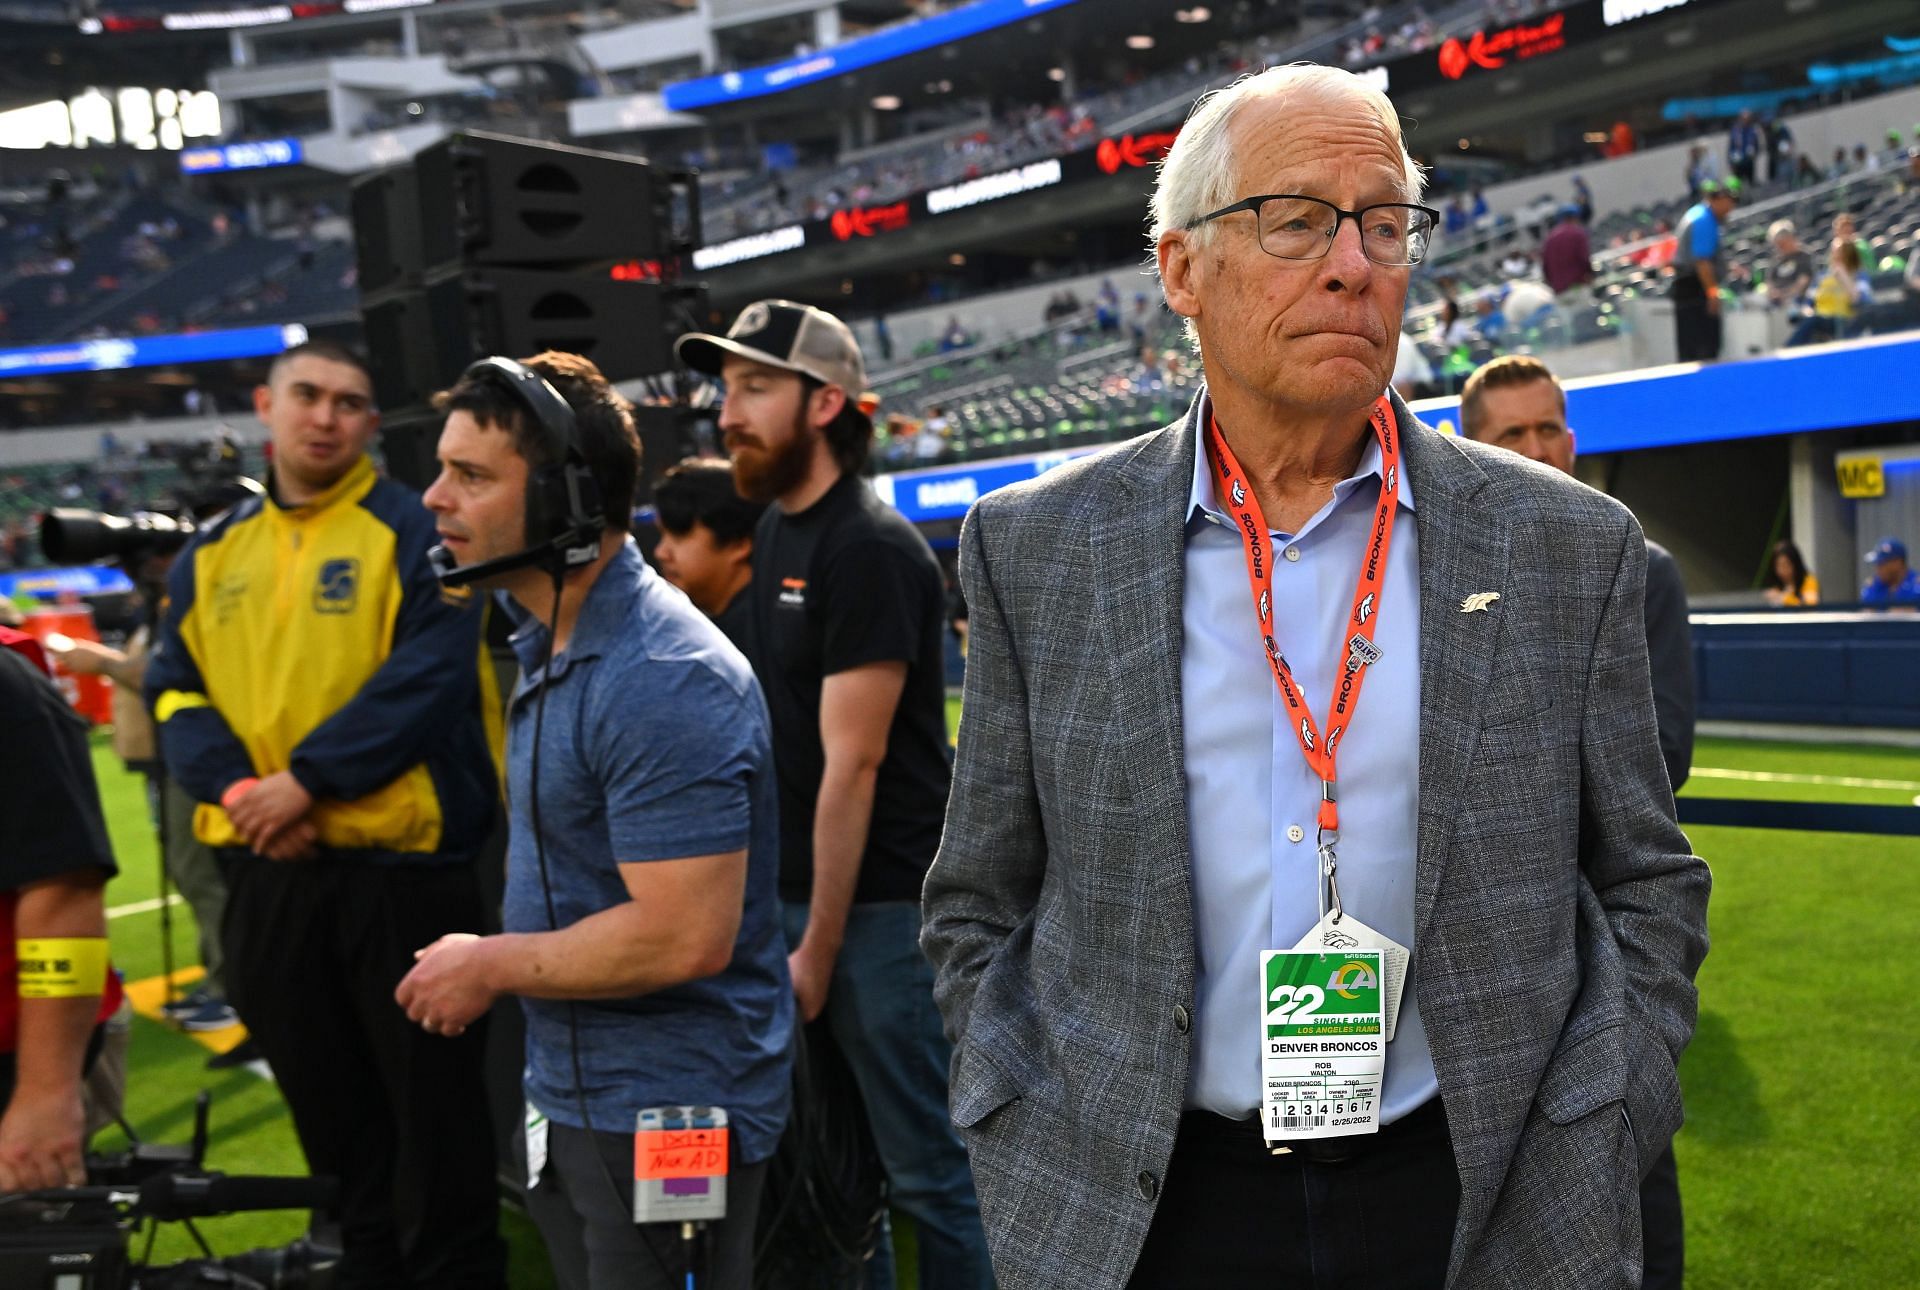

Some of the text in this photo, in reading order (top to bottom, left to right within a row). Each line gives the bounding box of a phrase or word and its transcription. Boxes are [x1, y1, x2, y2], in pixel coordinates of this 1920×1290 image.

[1240, 512, 1264, 579] BRONCOS
[1366, 504, 1388, 581] BRONCOS
[1350, 637, 1378, 661] CATCH
[1336, 667, 1356, 714] BRON
[1326, 962, 1378, 994] LA
[1266, 984, 1325, 1025] 22
[1313, 1016, 1380, 1025] SINGLE GAME
[1271, 1041, 1378, 1053] DENVER BRONCOS
[1272, 1101, 1372, 1116] 1 2 3 4 5 6 7
[1331, 1115, 1372, 1127] 12/25/2022
